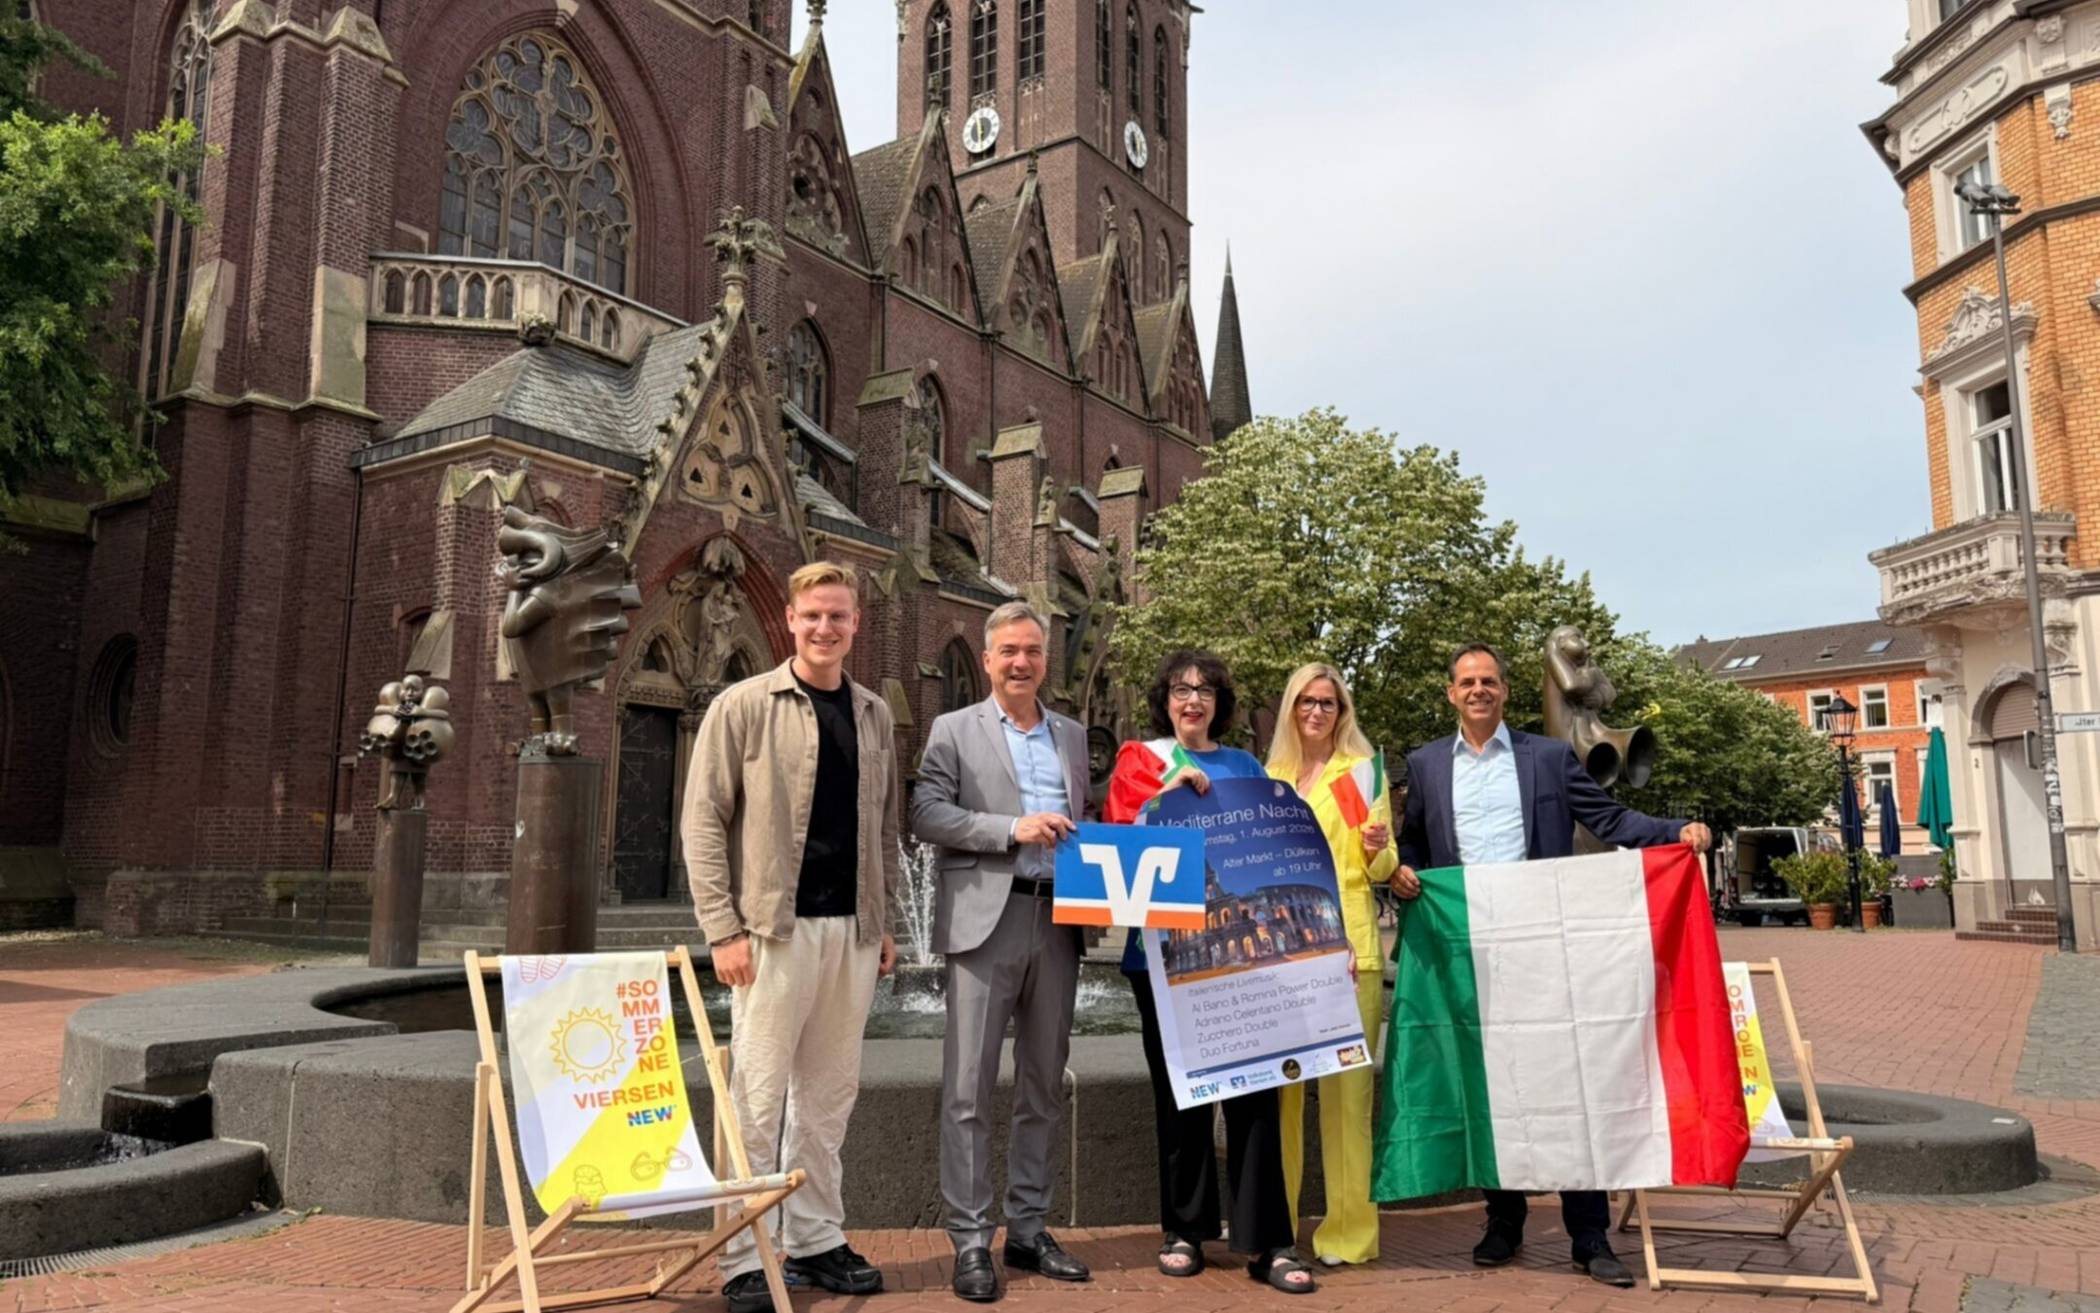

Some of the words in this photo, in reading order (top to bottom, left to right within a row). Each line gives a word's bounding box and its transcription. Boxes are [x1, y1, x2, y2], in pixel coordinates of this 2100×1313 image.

[1259, 803, 1310, 820] Nacht
[1251, 824, 1287, 838] August
[1223, 857, 1244, 869] Alter
[1246, 852, 1274, 865] Markt
[1273, 866, 1287, 877] ab
[1289, 863, 1301, 873] 19
[1302, 862, 1322, 872] Uhr
[616, 980, 657, 998] #SO
[1203, 999, 1230, 1012] Bano
[1231, 995, 1239, 1006] &
[1240, 989, 1278, 1004] Romina
[1278, 983, 1309, 996] Power
[1310, 975, 1343, 989] Double
[622, 998, 660, 1018] MM
[1233, 1004, 1281, 1020] Celentano
[1283, 996, 1316, 1010] Double
[633, 1017, 664, 1036] ER
[1197, 1026, 1241, 1044] Zucchero
[1244, 1019, 1279, 1034] Double
[634, 1035, 666, 1055] ZO
[1200, 1047, 1221, 1059] Duo
[1222, 1039, 1260, 1054] Fortuna
[639, 1053, 670, 1074] NE
[573, 1080, 675, 1109] VIERSEN
[1190, 1082, 1220, 1099] NEW
[627, 1106, 673, 1127] NEW
